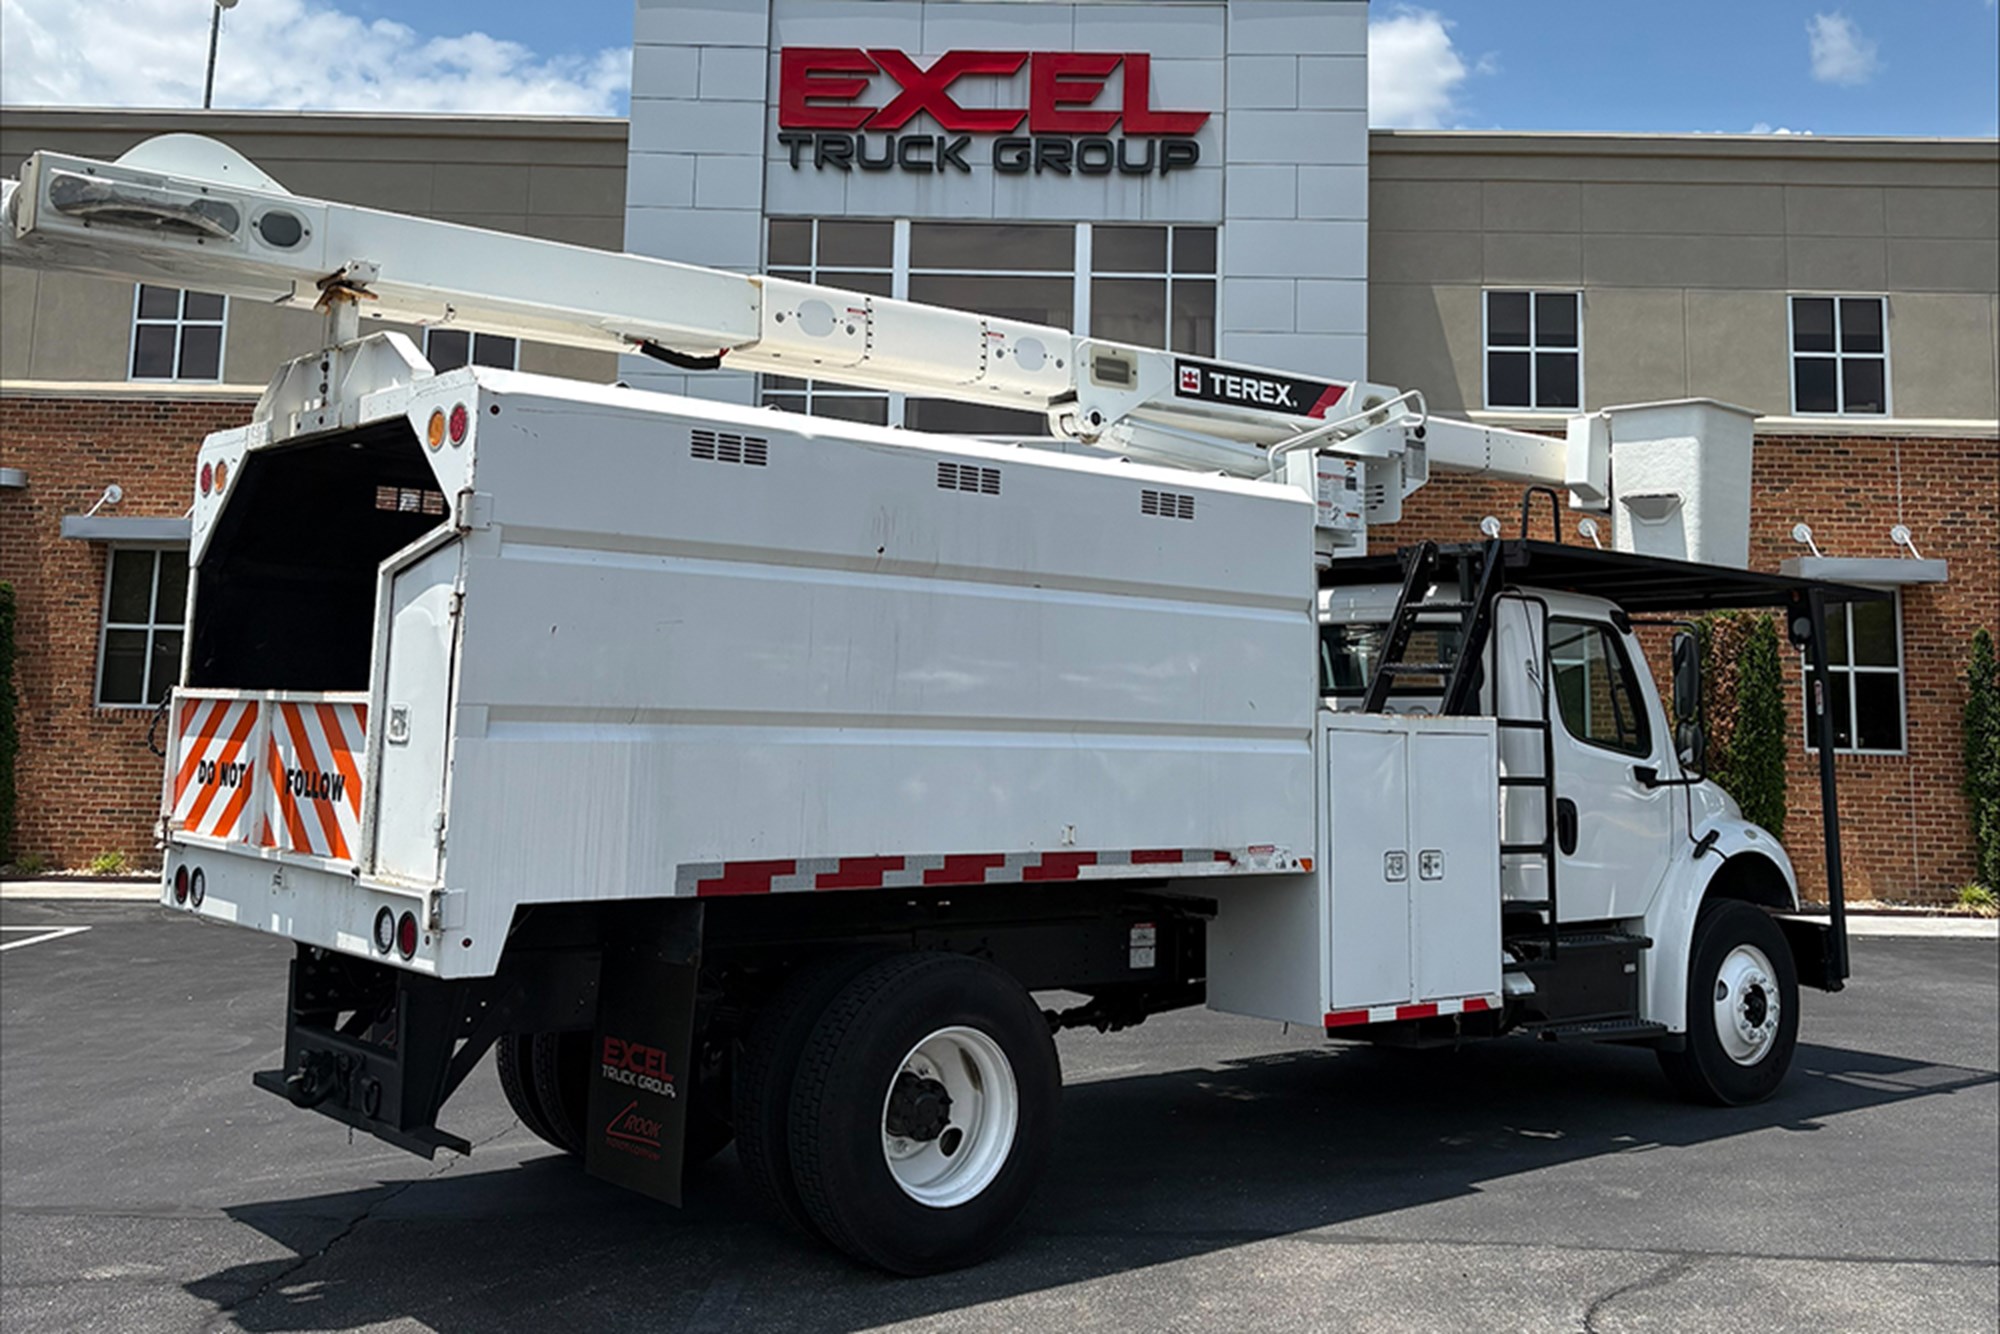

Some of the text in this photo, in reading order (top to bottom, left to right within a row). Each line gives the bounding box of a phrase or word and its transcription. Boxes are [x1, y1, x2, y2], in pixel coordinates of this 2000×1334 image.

[778, 47, 1212, 136] EXCEL
[778, 133, 1200, 177] TRUCK GROUP
[1209, 372, 1291, 407] TEREX
[198, 760, 246, 788] DO NOT
[285, 768, 345, 802] FOLLOW
[602, 1035, 674, 1082] EXCEL
[602, 1064, 674, 1096] TRUCK GROUP
